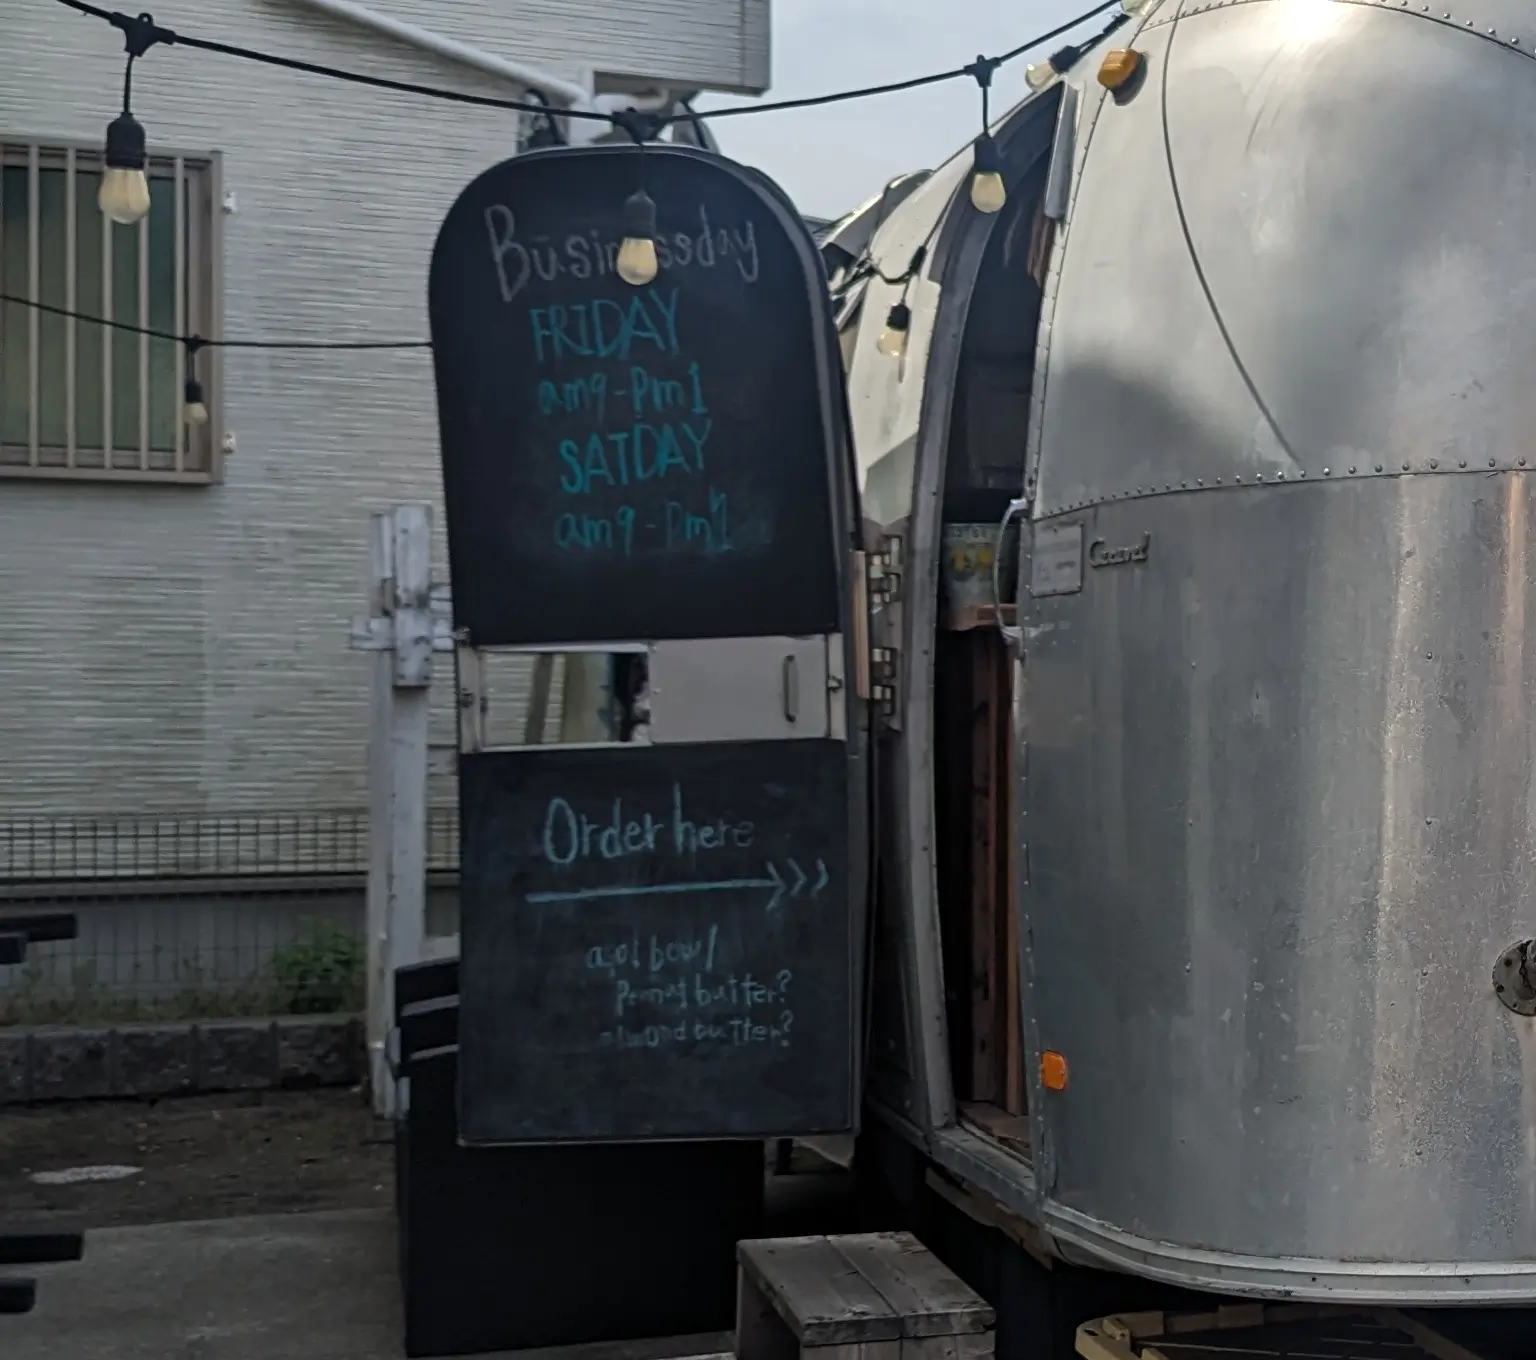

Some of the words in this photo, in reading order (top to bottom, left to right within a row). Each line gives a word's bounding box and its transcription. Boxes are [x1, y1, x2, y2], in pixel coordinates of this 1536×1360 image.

[529, 287, 680, 362] FRIDAY
[559, 417, 713, 495] SATDAY
[543, 797, 664, 865] Order
[672, 781, 756, 856] here
